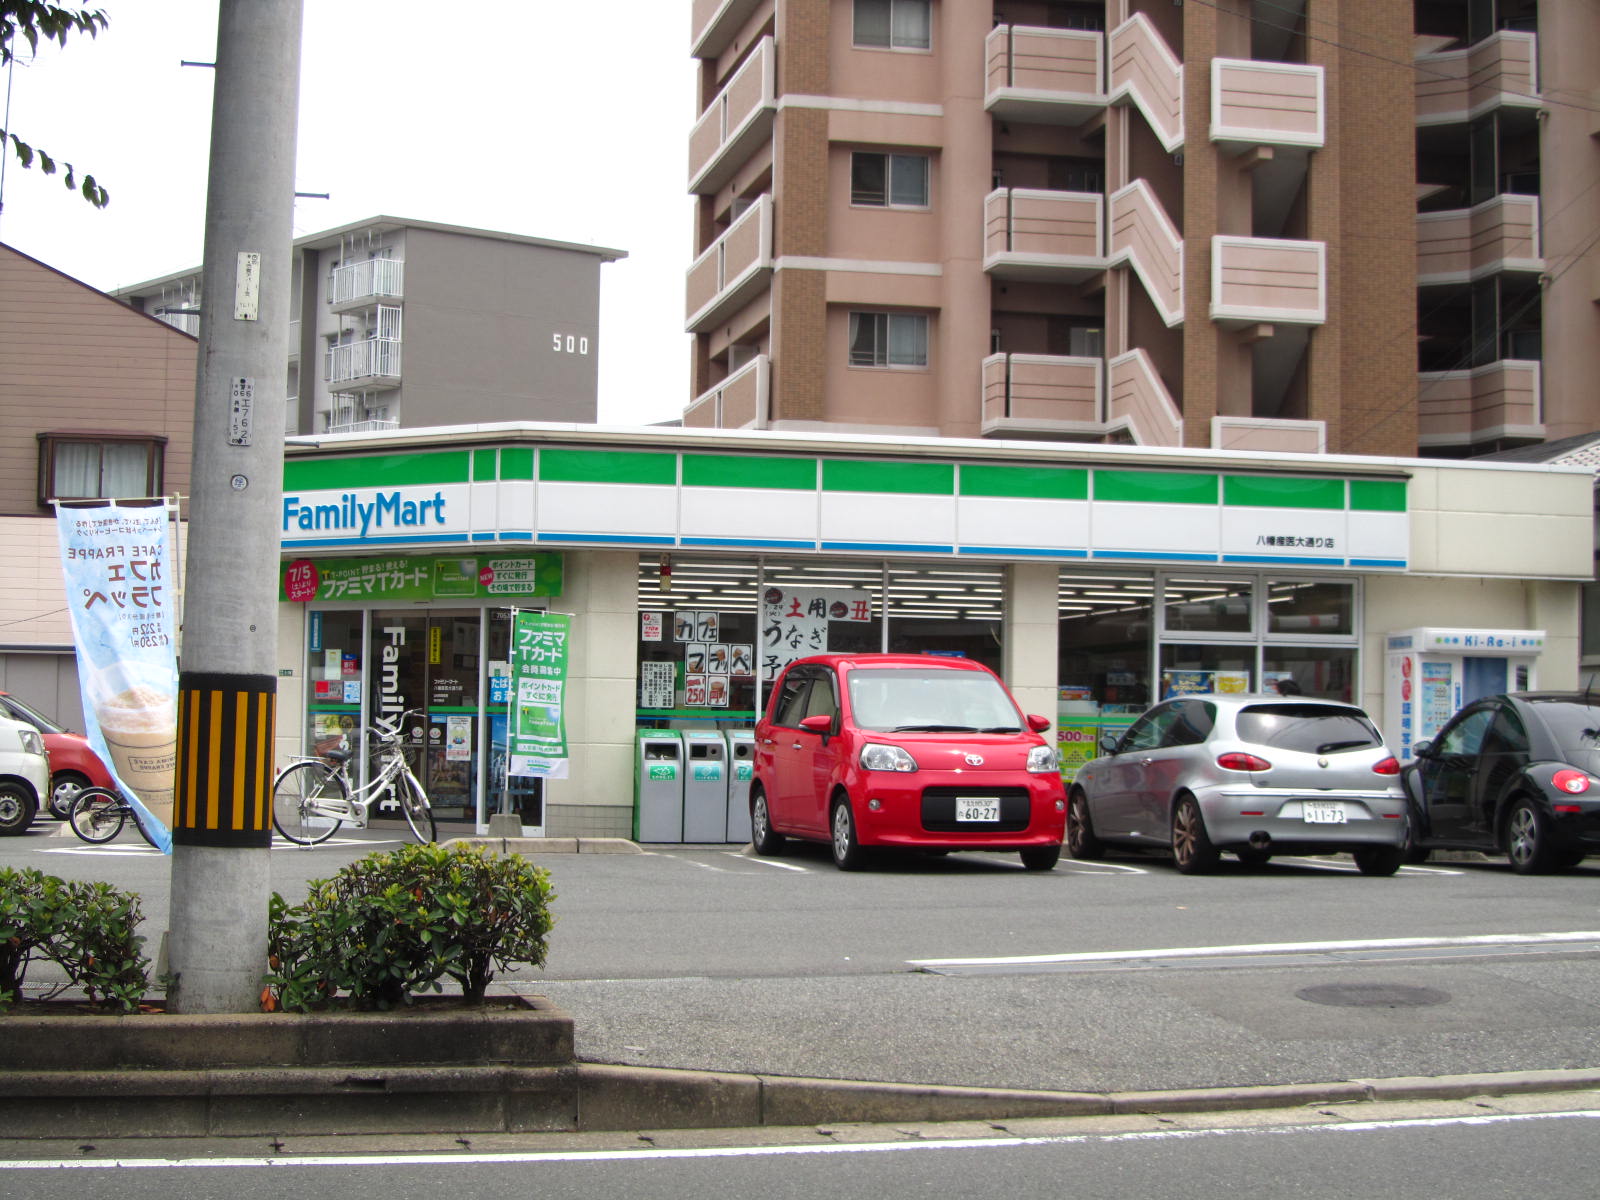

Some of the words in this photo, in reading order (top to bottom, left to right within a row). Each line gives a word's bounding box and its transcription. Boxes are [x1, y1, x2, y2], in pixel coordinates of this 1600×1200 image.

[552, 333, 588, 355] 500
[283, 491, 446, 538] FamilyMart
[289, 565, 311, 582] 7/5
[322, 567, 428, 599] ファミマTカード
[519, 628, 565, 646] ファミマ
[763, 619, 827, 650] うなぎ
[519, 645, 562, 663] Tカード
[965, 807, 997, 820] 60-27
